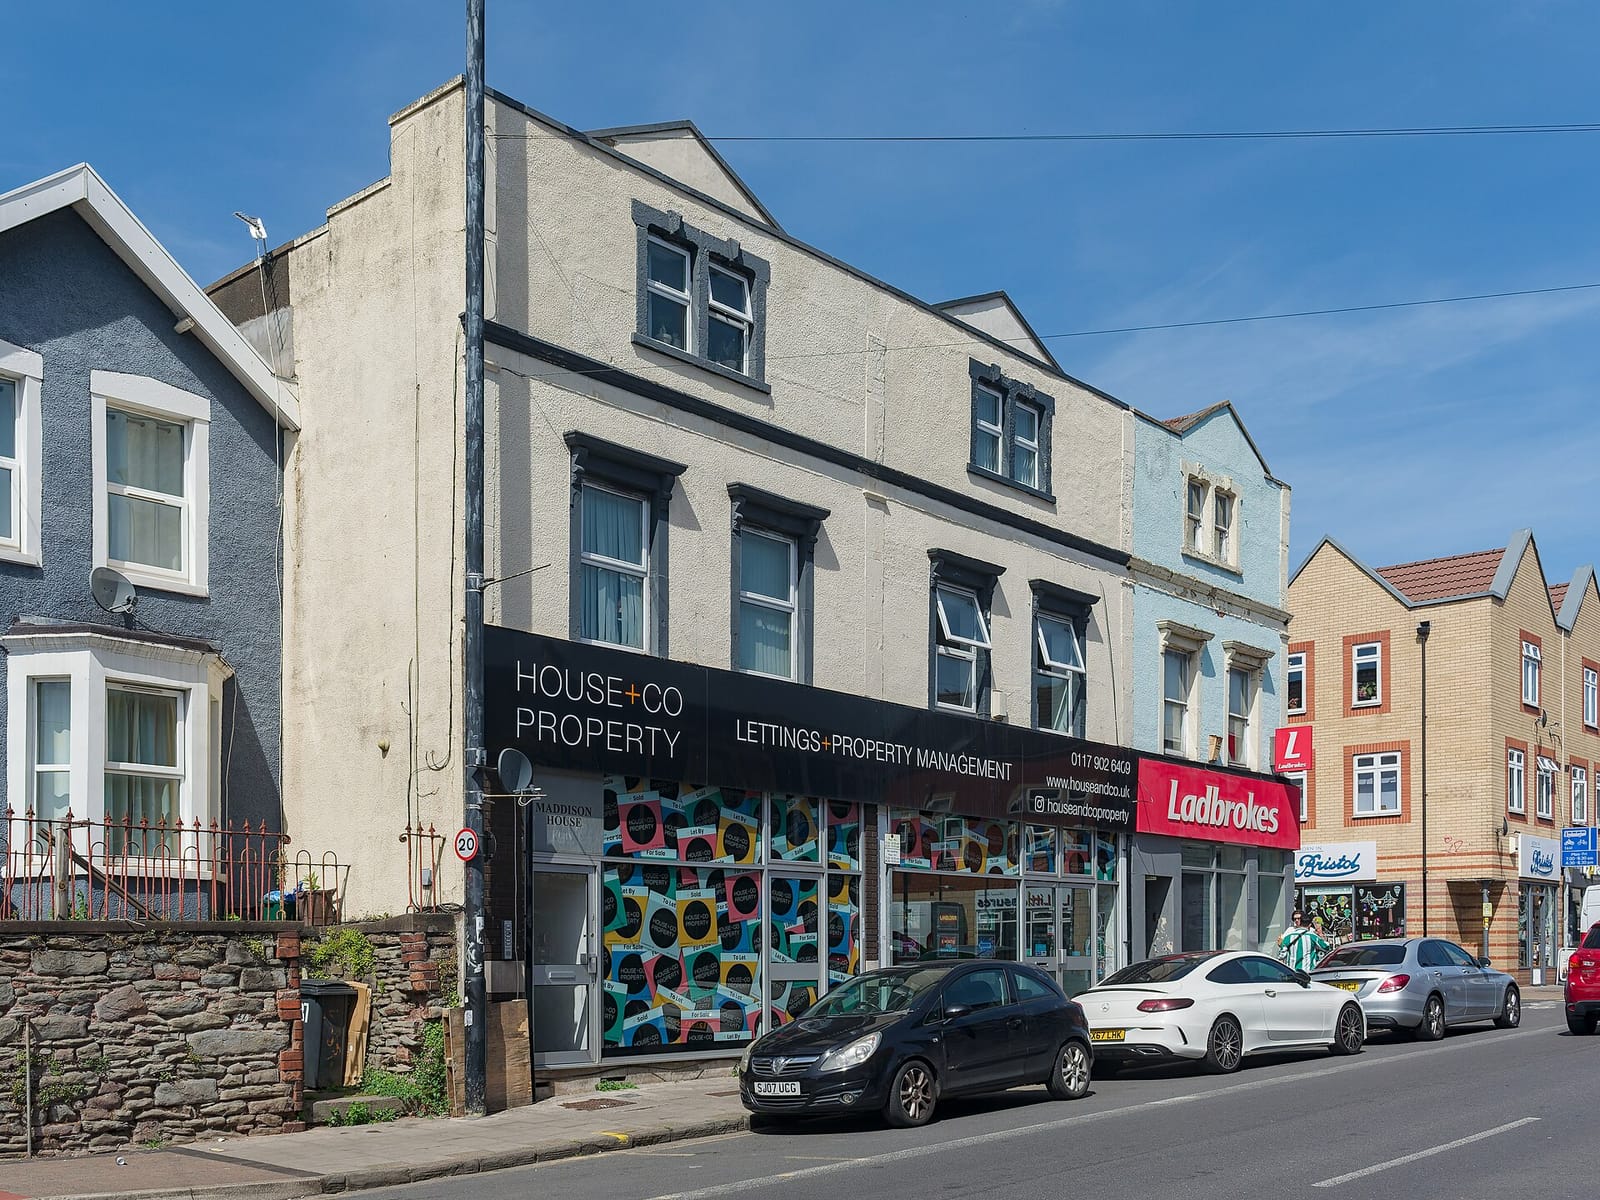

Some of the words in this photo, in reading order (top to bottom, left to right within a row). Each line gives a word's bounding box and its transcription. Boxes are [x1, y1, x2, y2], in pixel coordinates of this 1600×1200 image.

[516, 660, 683, 717] HOUSE+CO
[516, 707, 681, 759] PROPERTY
[736, 719, 913, 766] LETTINGS+PROPERTY
[916, 747, 1013, 781] MANAGEMENT
[1284, 731, 1301, 759] L
[1071, 752, 1092, 768] 0117
[1094, 756, 1109, 772] 902
[1110, 759, 1131, 775] 6409
[1277, 762, 1307, 770] Ladbrokes
[1046, 776, 1130, 798] www.houseandco.uk
[535, 802, 592, 817] MADDISON
[1047, 798, 1130, 825] houseandcoproperty
[1167, 779, 1279, 833] Ladbrokes
[547, 816, 583, 828] HOUSE
[457, 837, 475, 852] 20
[1295, 852, 1361, 877] Bristol
[637, 1014, 649, 1022] Sold
[1090, 1031, 1105, 1040] X67
[1107, 1030, 1122, 1039] LHK
[757, 1083, 777, 1093] SJ07
[779, 1082, 797, 1093] UCG
